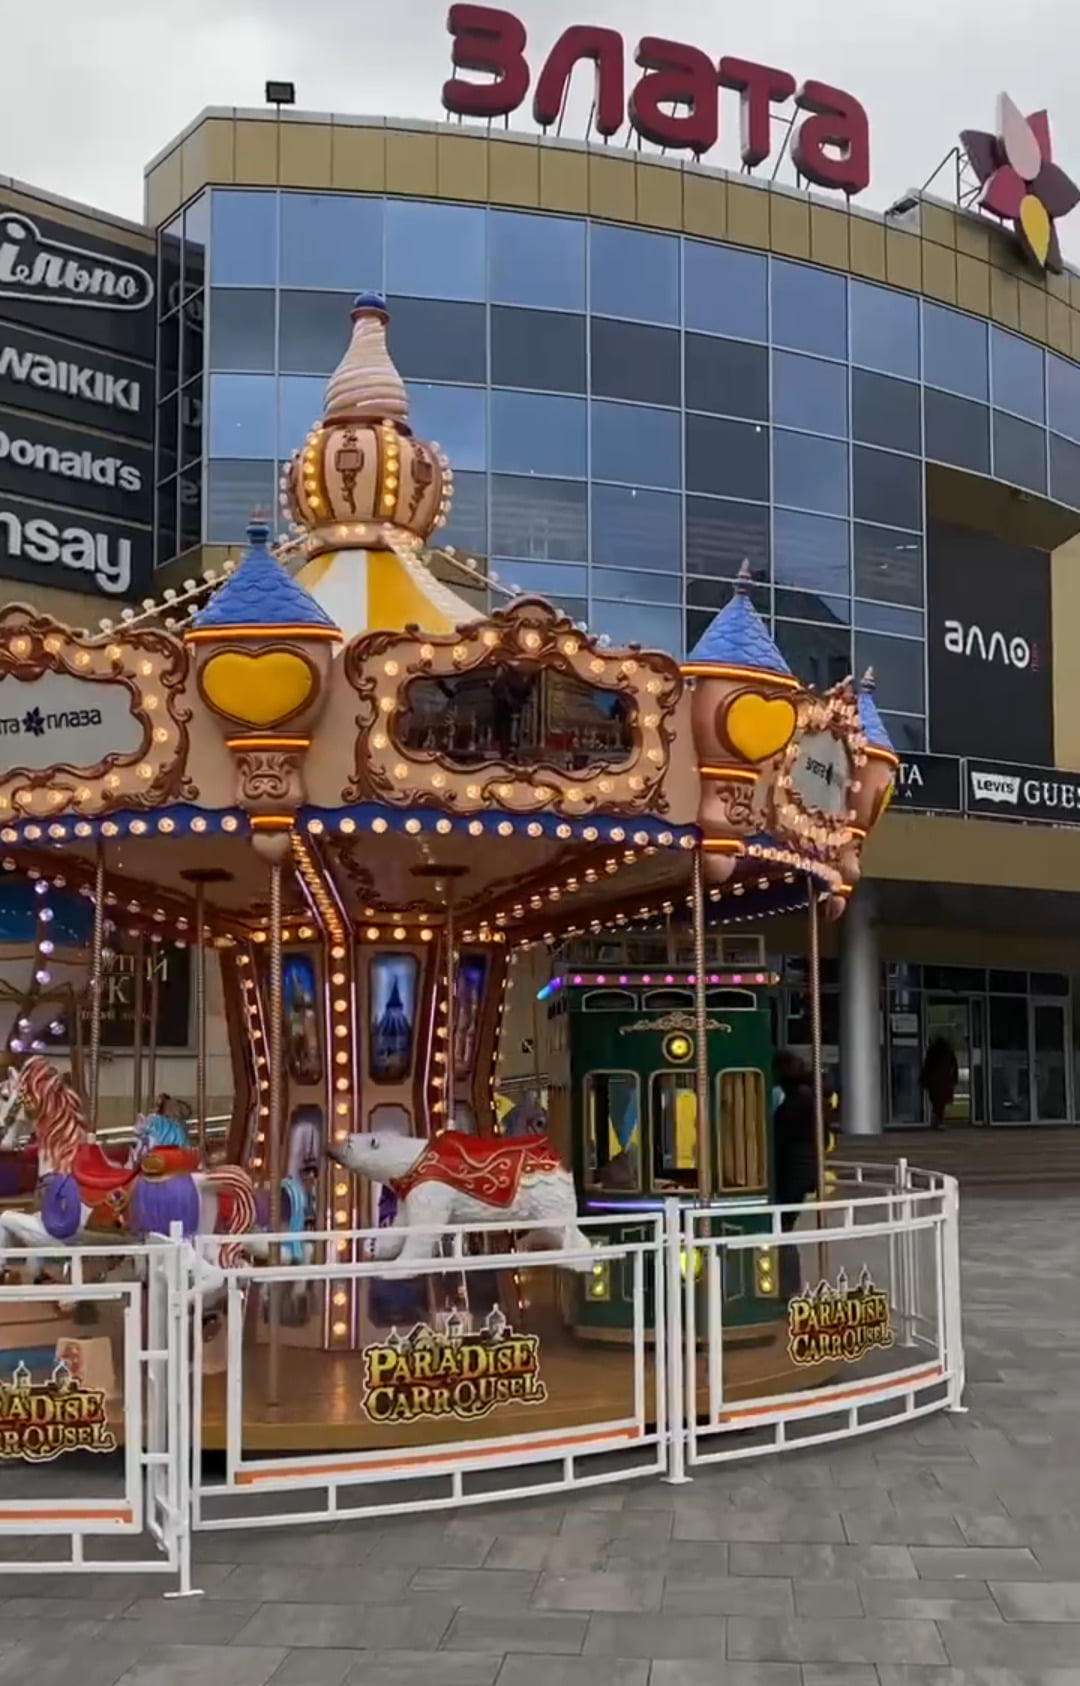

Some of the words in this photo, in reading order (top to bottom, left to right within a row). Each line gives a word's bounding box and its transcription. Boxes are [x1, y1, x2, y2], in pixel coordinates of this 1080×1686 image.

[0, 1393, 103, 1424] ADISE
[366, 1373, 544, 1420] CARROUSEL
[0, 1422, 112, 1456] ROUSEL
